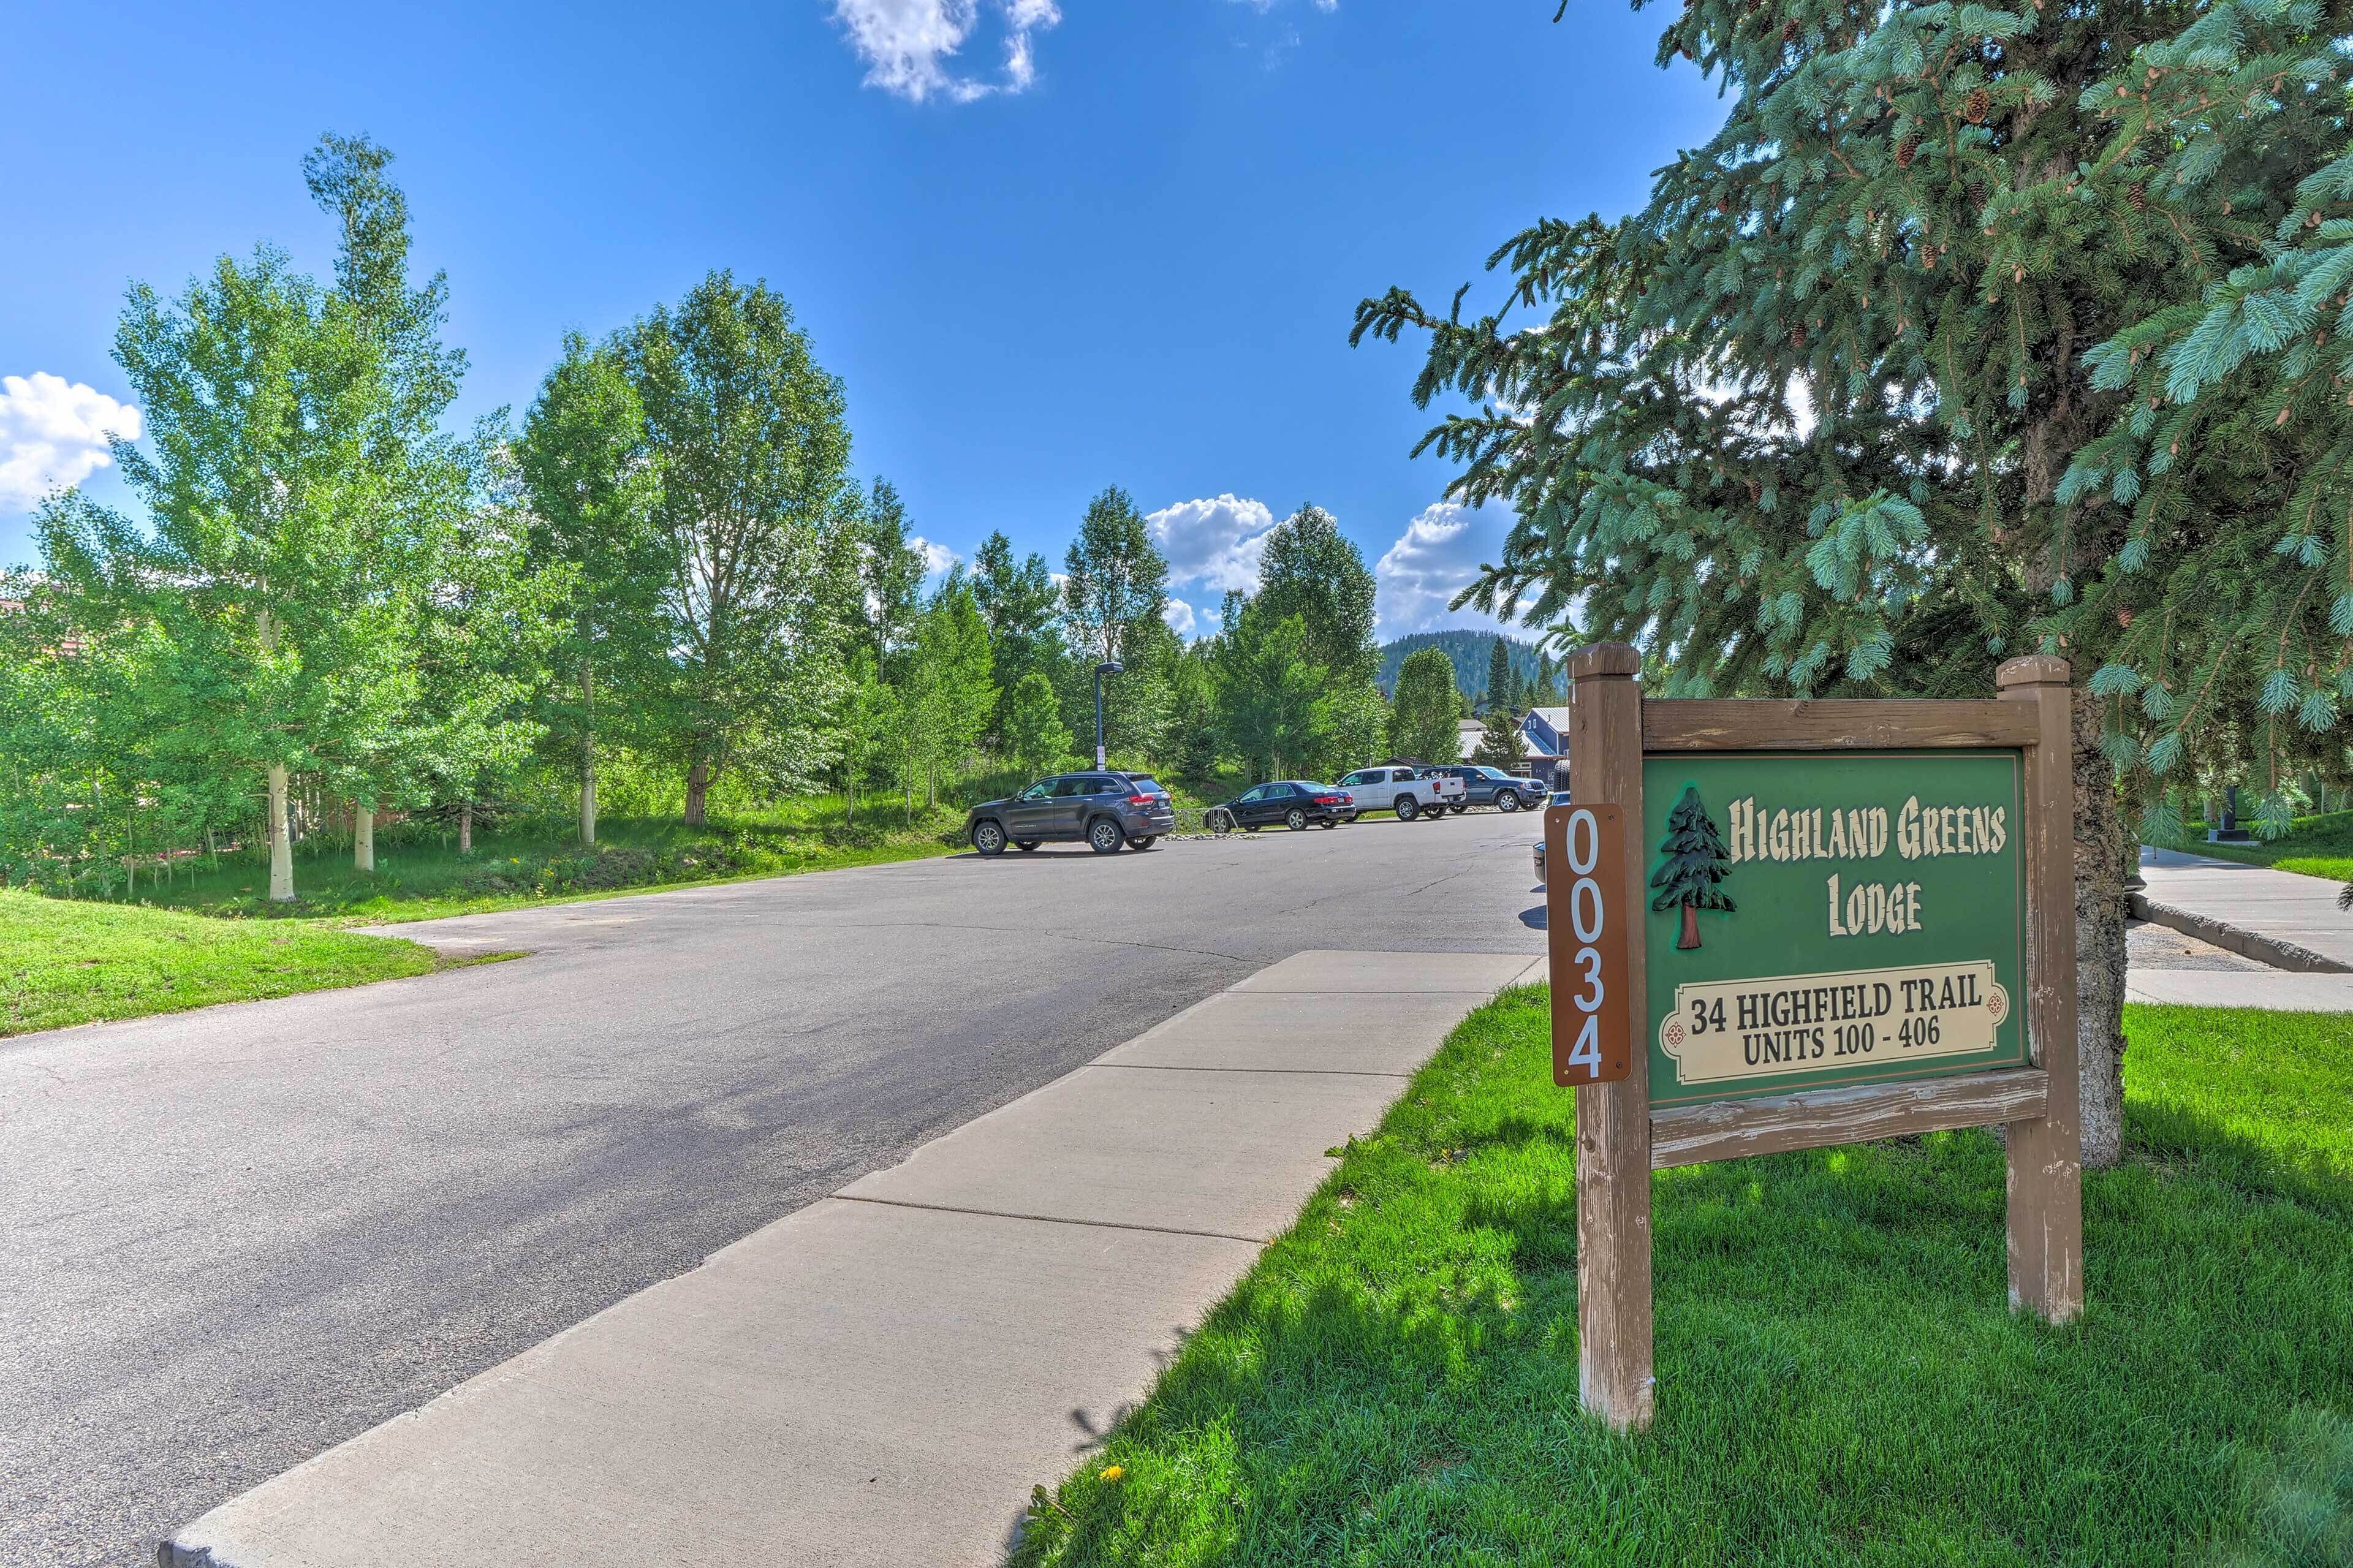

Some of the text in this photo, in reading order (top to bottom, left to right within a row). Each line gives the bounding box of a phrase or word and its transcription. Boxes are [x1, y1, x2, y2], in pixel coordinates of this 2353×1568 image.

[1728, 795, 2007, 865] HIGHLAND GREENS
[1827, 873, 1922, 937] LODGE
[1567, 809, 1604, 1078] 0034
[1691, 974, 1982, 1035] 34 HIGHFIELD TRAIL
[1743, 1027, 1825, 1066] UNITS
[1833, 1022, 1874, 1056] 100
[1899, 1015, 1941, 1048] 406
